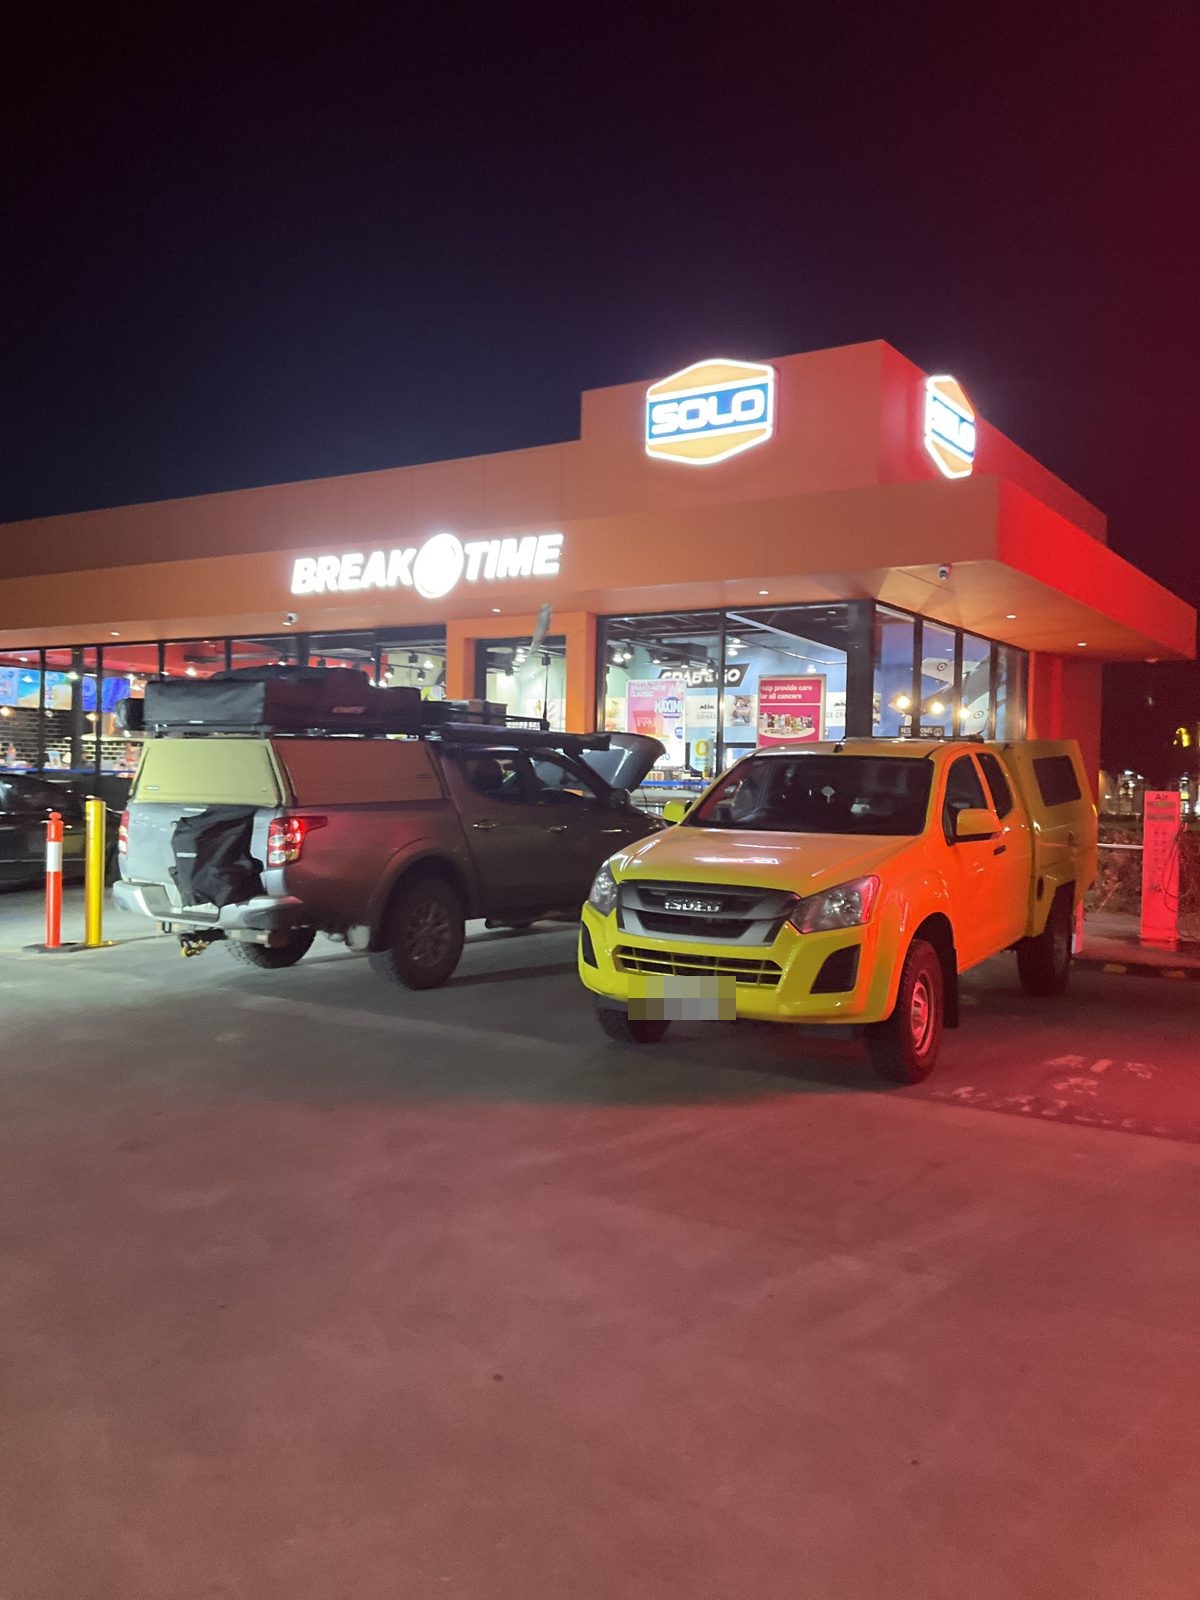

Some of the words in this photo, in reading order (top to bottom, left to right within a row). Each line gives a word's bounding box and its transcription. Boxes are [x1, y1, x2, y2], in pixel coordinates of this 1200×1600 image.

[651, 389, 765, 435] SOLO
[291, 548, 417, 594] BREAK
[463, 533, 563, 581] TIME
[774, 684, 798, 692] provide
[664, 899, 720, 912] ISUZU
